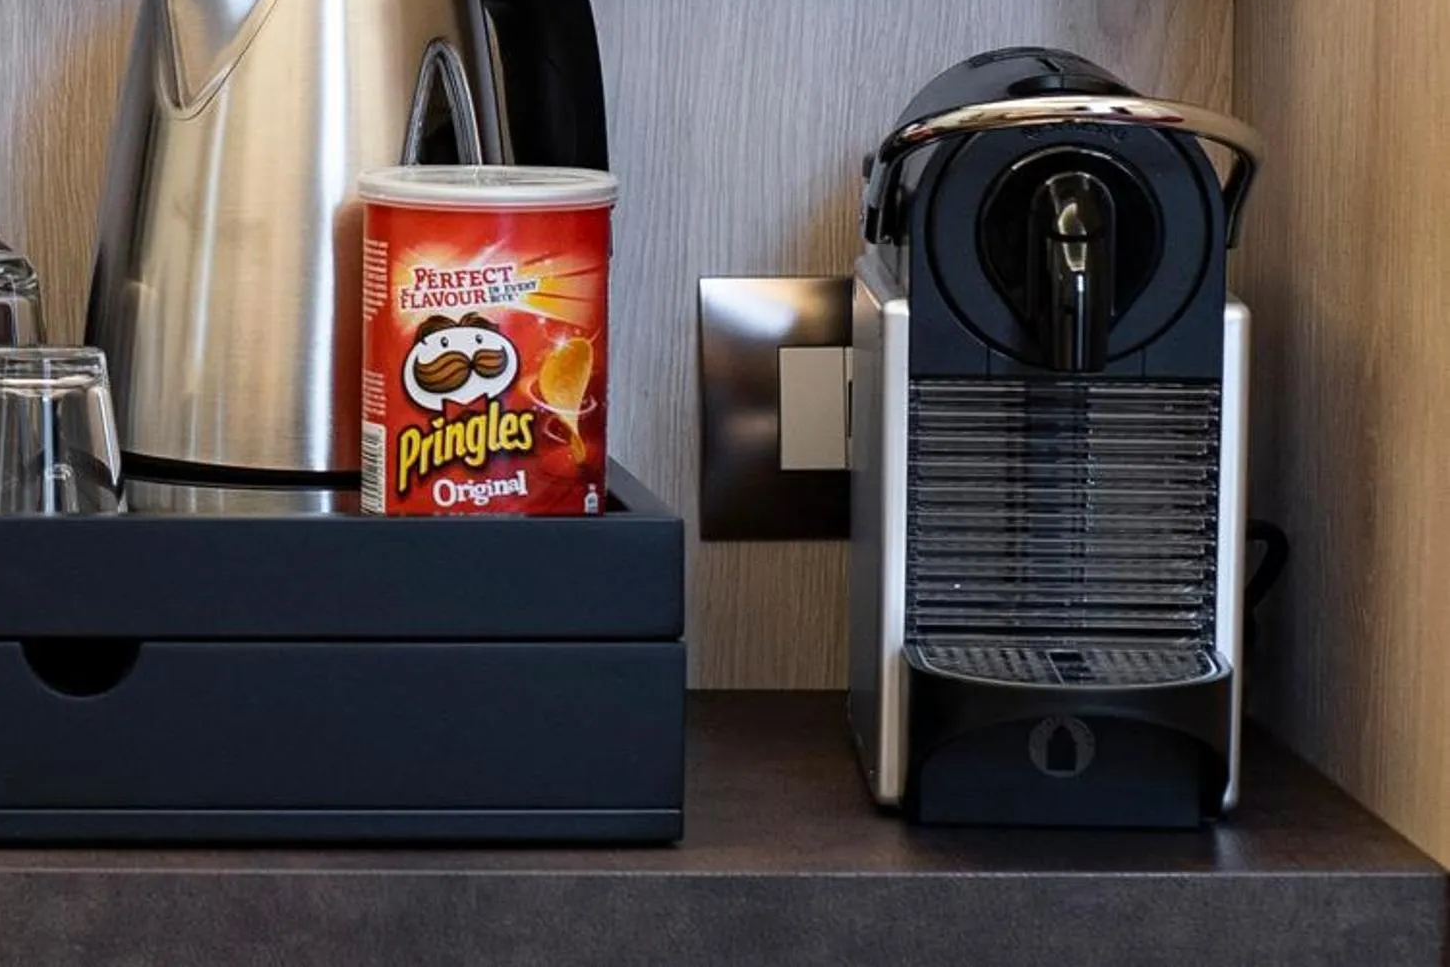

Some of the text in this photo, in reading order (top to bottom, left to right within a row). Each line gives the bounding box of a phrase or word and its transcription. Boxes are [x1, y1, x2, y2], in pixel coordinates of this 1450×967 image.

[413, 265, 514, 291] PERFECT
[400, 288, 487, 310] FLAVOUR
[399, 401, 534, 493] Pringles
[433, 469, 528, 508] Original
